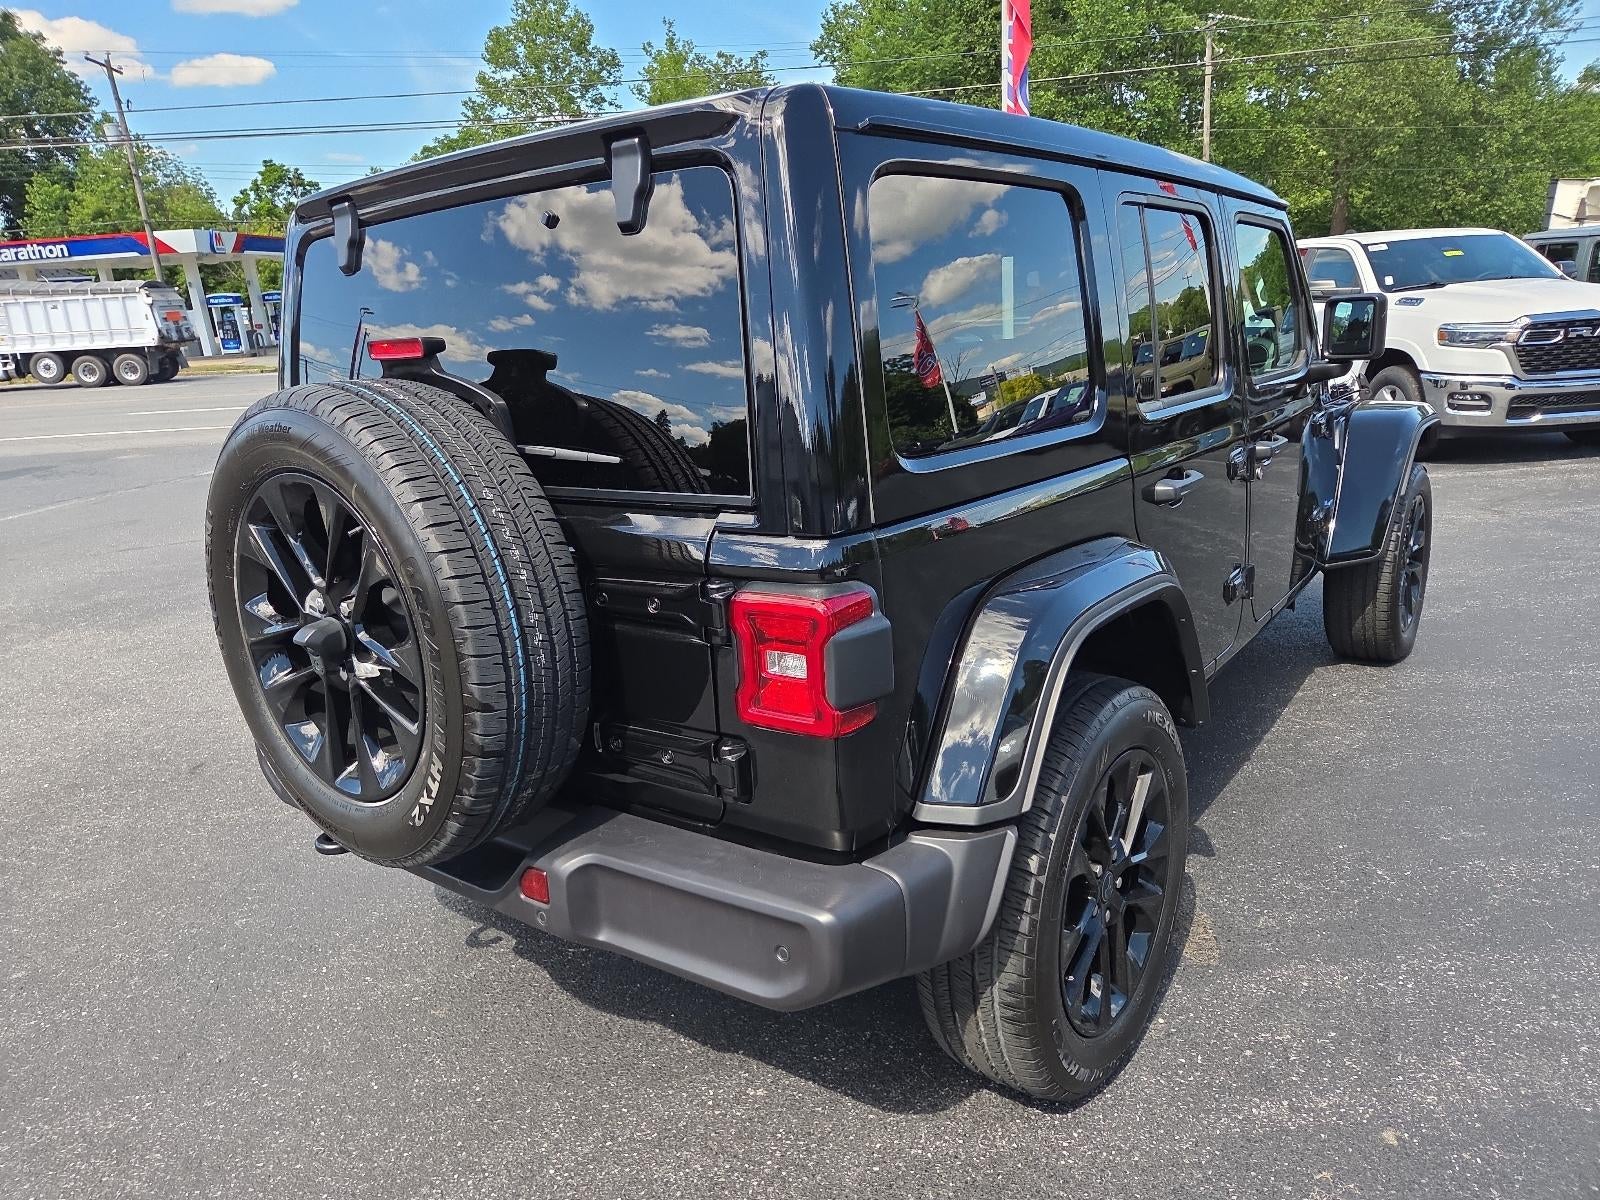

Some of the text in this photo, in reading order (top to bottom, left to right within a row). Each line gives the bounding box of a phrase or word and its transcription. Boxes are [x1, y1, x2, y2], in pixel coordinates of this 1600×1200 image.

[0, 243, 69, 261] arathon
[246, 421, 292, 435] ll-Weather
[409, 752, 444, 827] HTX2
